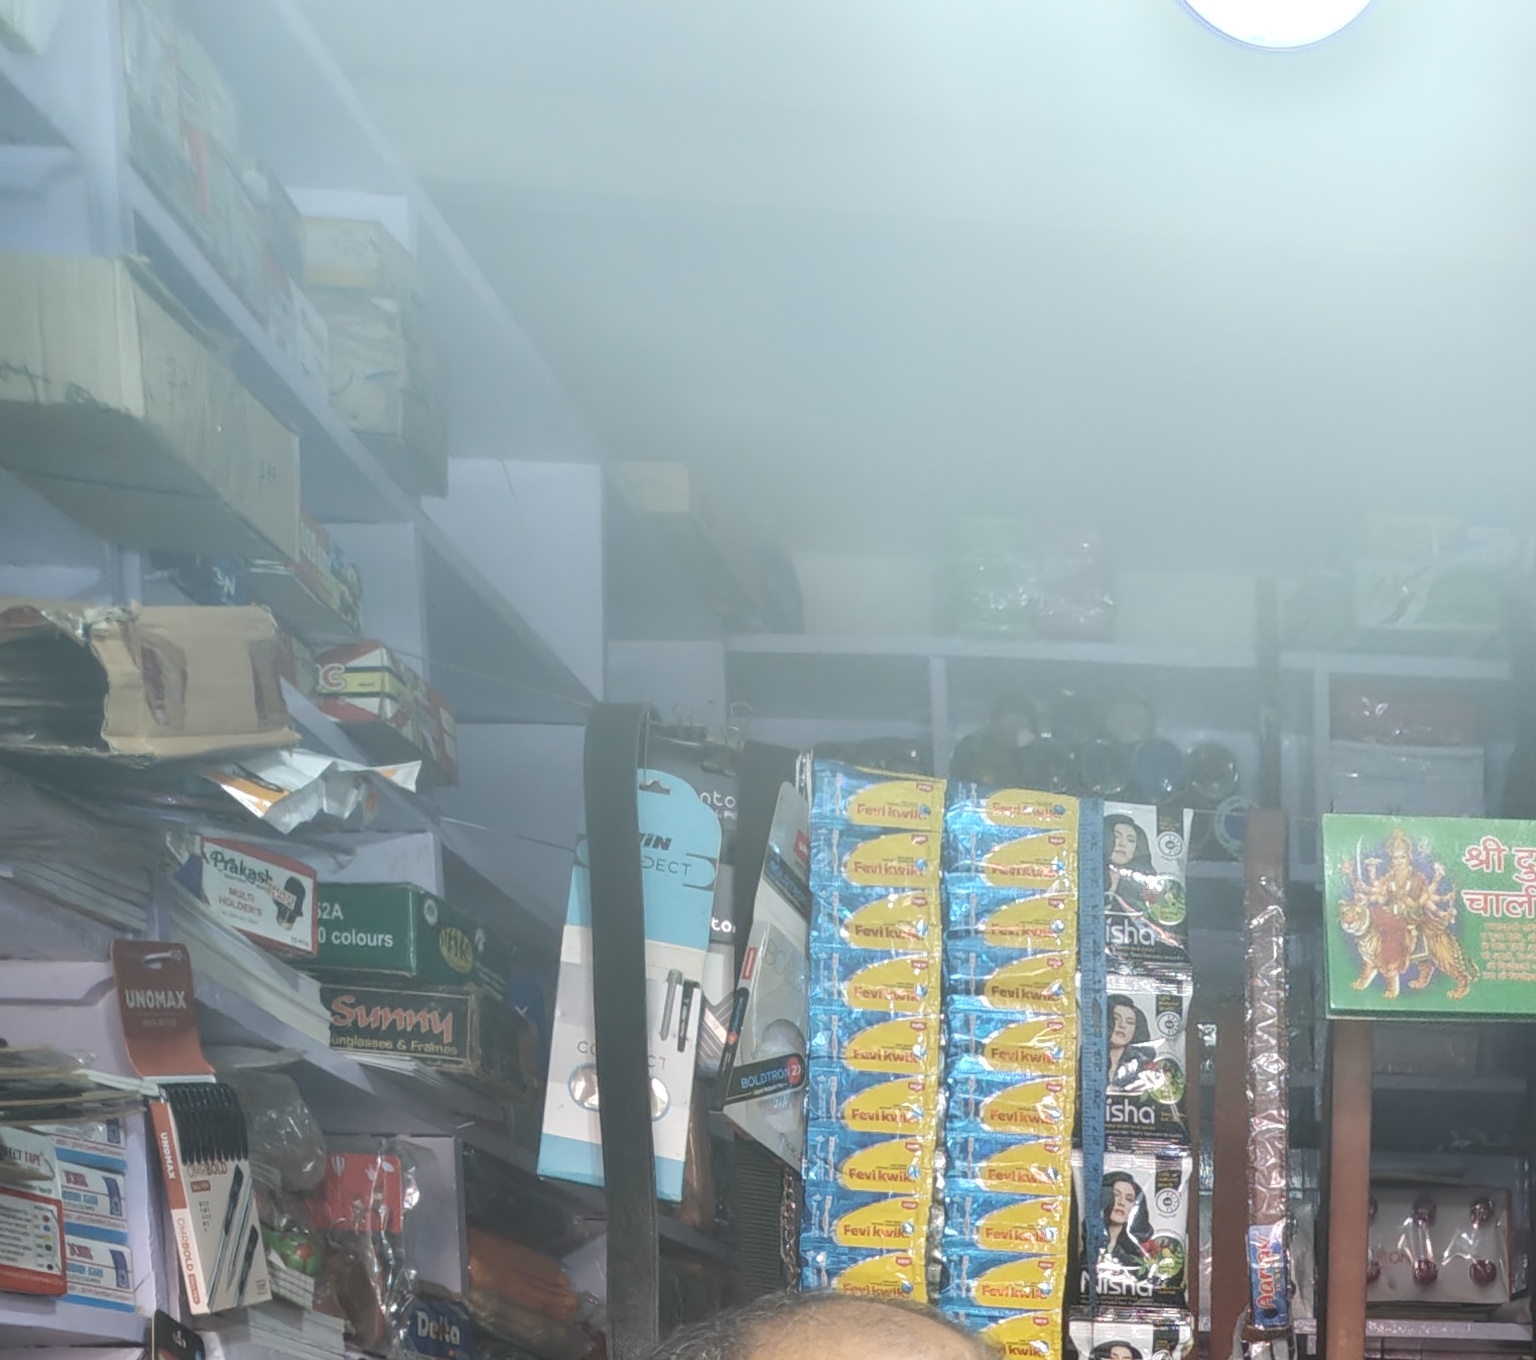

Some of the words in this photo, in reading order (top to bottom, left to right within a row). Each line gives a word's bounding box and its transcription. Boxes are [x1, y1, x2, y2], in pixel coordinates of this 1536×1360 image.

[1462, 836, 1508, 873] श्री
[331, 930, 393, 948] colours
[125, 989, 187, 1009] UNOMAX
[331, 995, 454, 1043] Sunny
[331, 1036, 393, 1051] unglasses
[410, 1040, 458, 1056] Frames
[160, 1132, 176, 1180] UNOMAX
[417, 1310, 461, 1345] Delta
